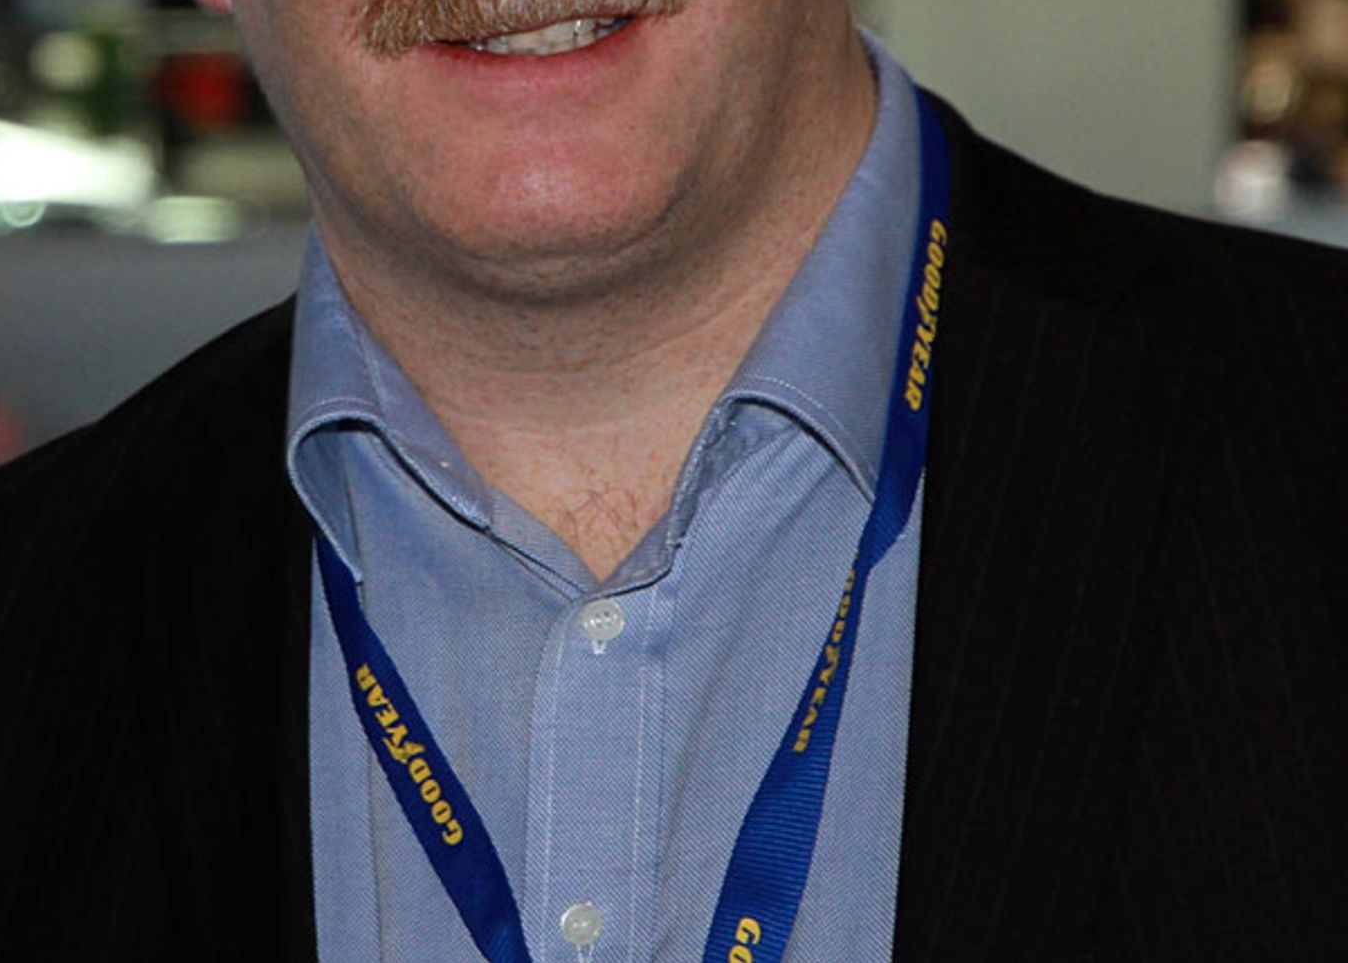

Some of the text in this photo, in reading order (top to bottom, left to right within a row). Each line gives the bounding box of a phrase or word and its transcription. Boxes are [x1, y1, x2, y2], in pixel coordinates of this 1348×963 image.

[904, 219, 947, 412] GOODYEAR
[793, 568, 856, 753] OODYEAR
[355, 664, 464, 846] GOODYEAR
